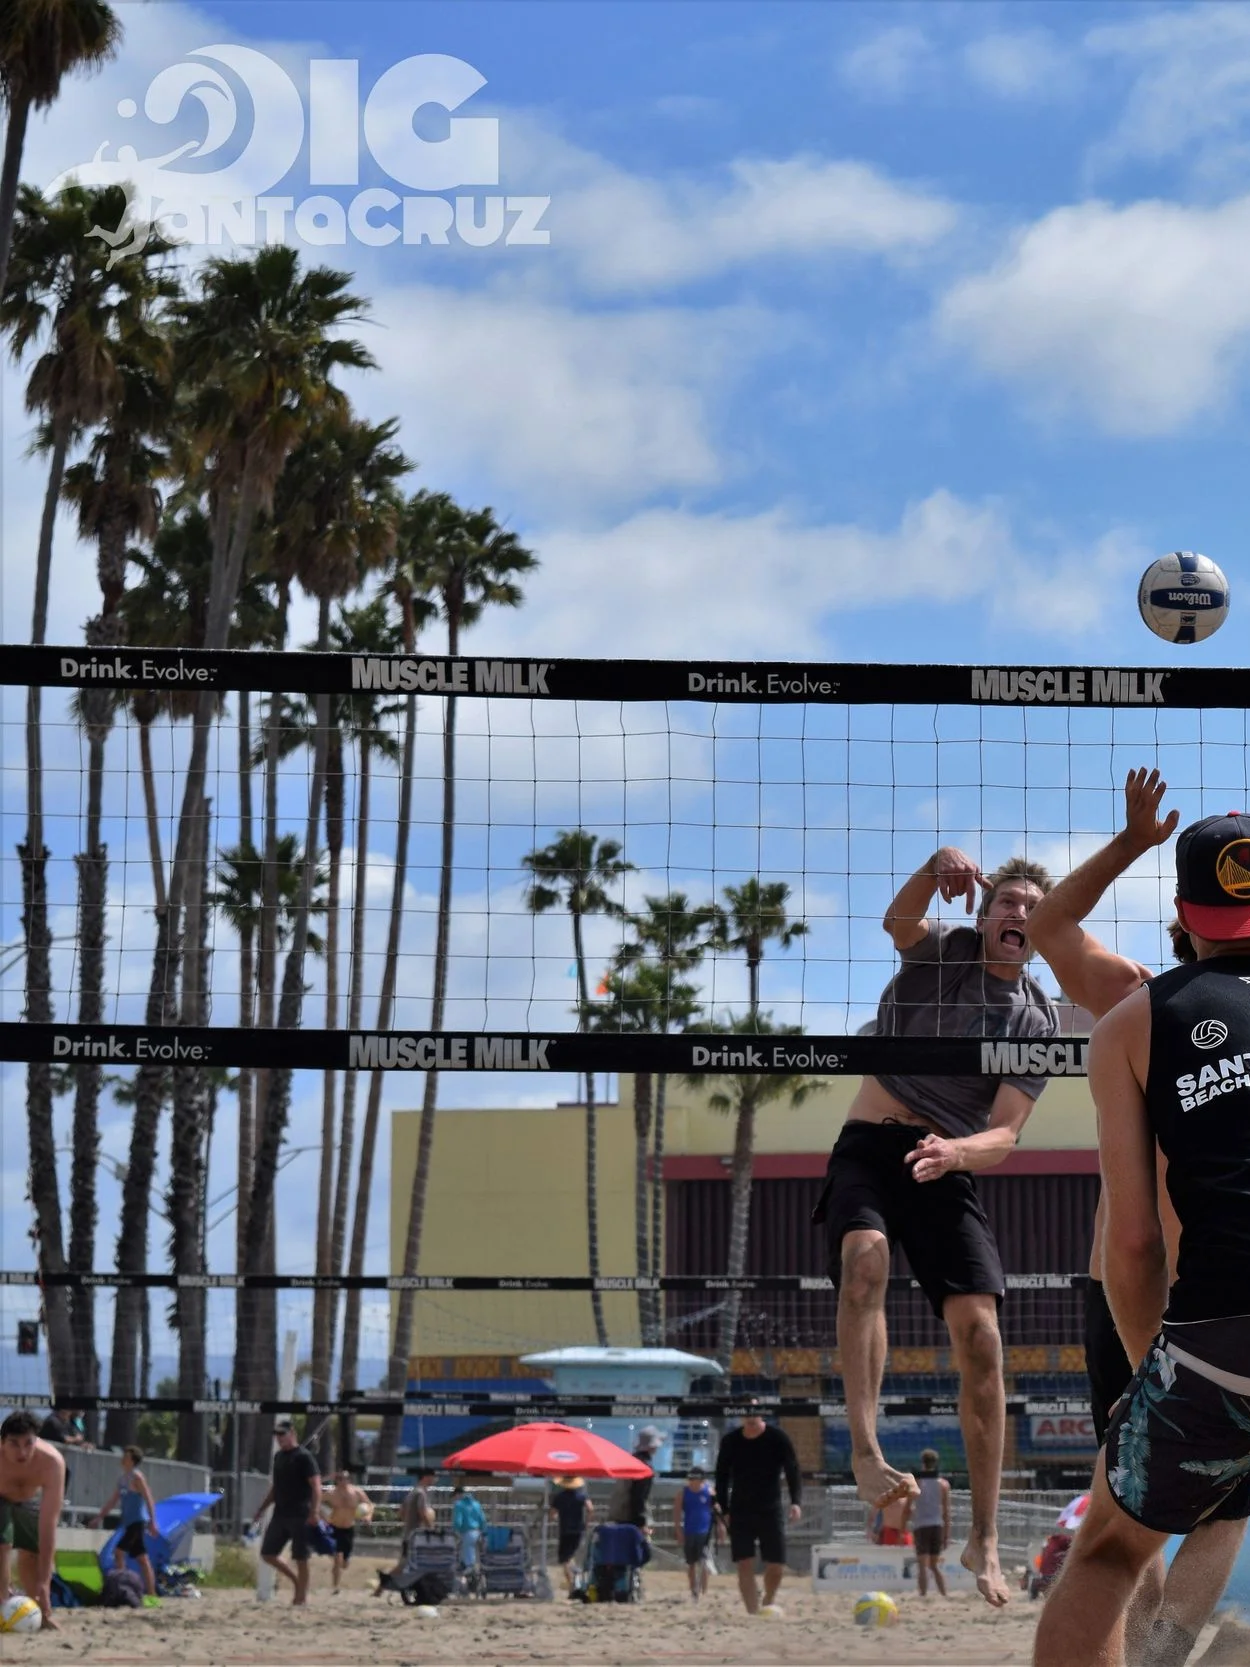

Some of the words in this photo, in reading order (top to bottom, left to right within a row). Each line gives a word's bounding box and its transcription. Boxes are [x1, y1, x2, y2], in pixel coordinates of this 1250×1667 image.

[1168, 591, 1212, 606] Wilson
[60, 658, 138, 680] Drink.
[351, 658, 469, 691] MUSCLE
[474, 660, 551, 694] MILK
[688, 673, 763, 695] Drink.
[971, 669, 1085, 702] MUSCLE
[1092, 670, 1165, 702] MILK
[53, 1036, 132, 1059] Drink.
[348, 1035, 468, 1070] MUSCLE
[474, 1037, 551, 1070] MILK
[692, 1045, 768, 1068] Drink.
[1180, 1073, 1250, 1113] BEACH
[1005, 1276, 1045, 1289] MUSCLE
